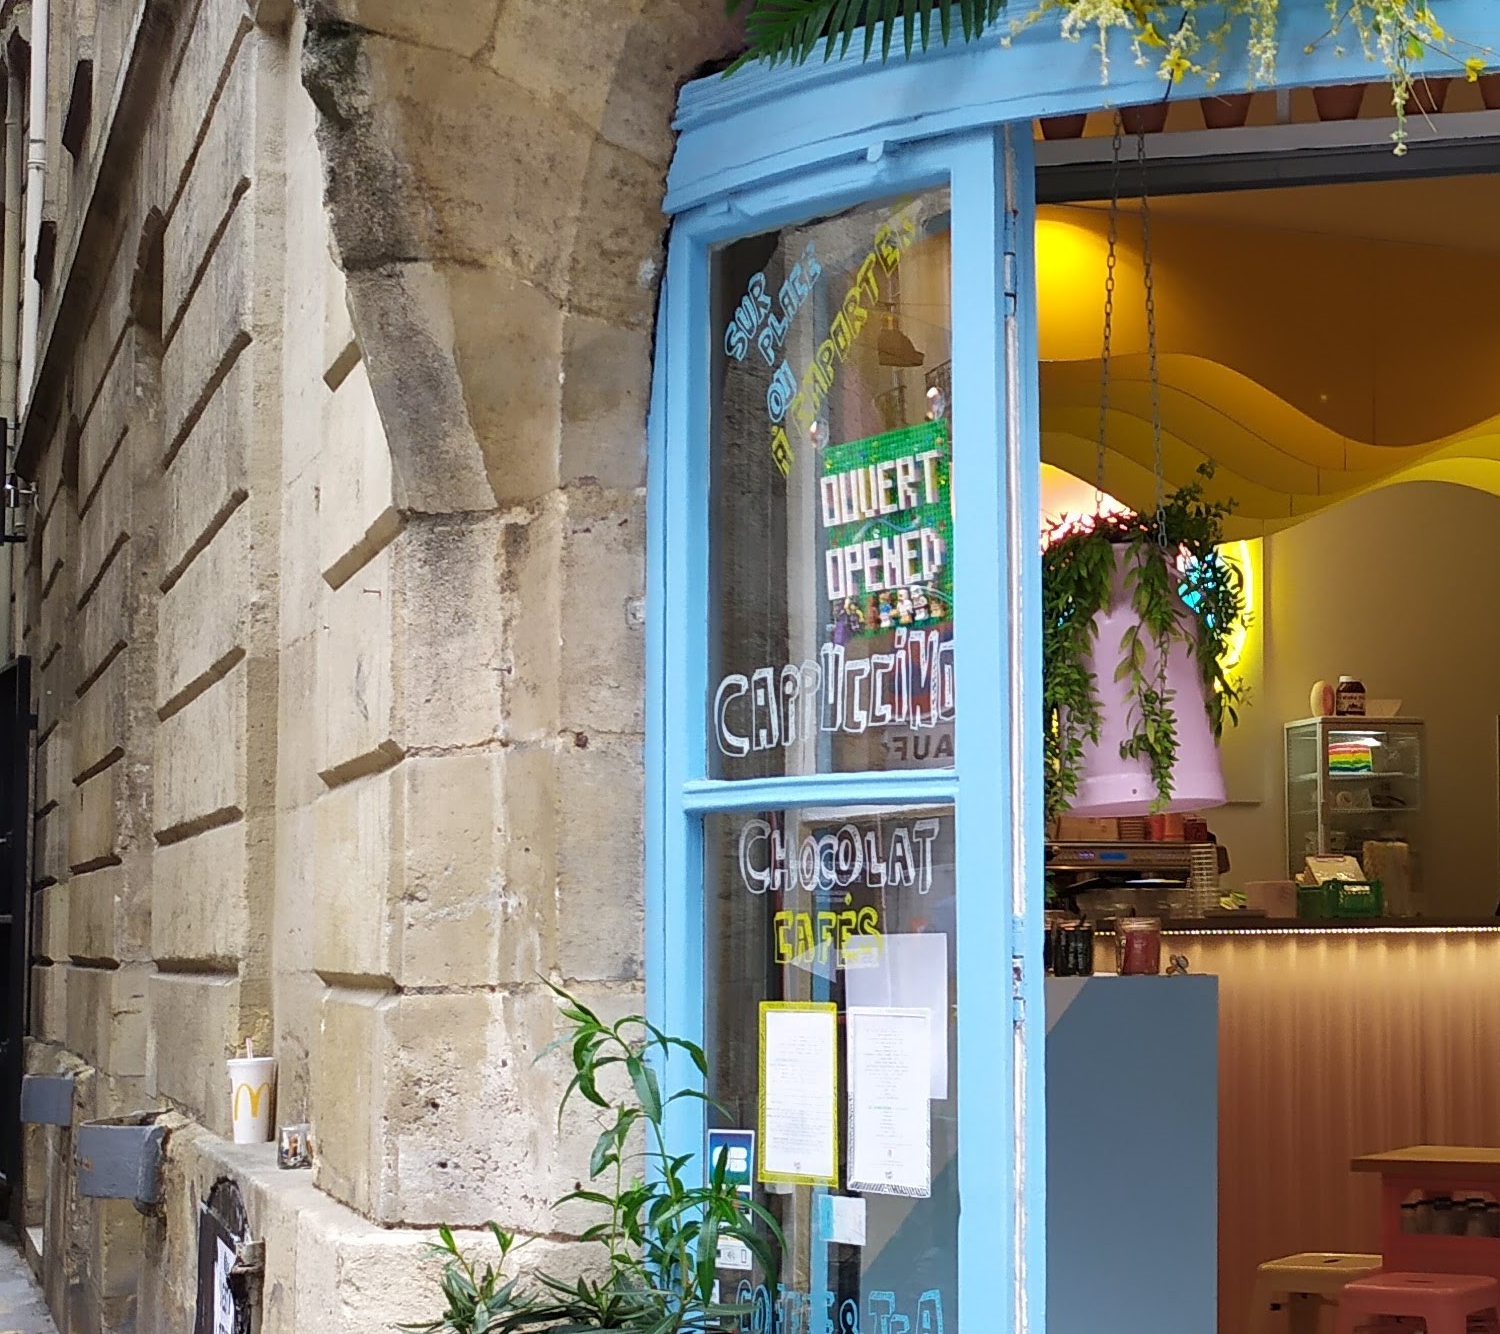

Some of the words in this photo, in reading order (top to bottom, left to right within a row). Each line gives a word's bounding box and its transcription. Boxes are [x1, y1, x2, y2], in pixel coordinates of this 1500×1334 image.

[724, 271, 771, 362] SUR
[757, 241, 822, 366] PLACE
[820, 449, 943, 527] OUVERT
[825, 528, 945, 600] OPENED
[738, 819, 939, 894] CHOCOLAT
